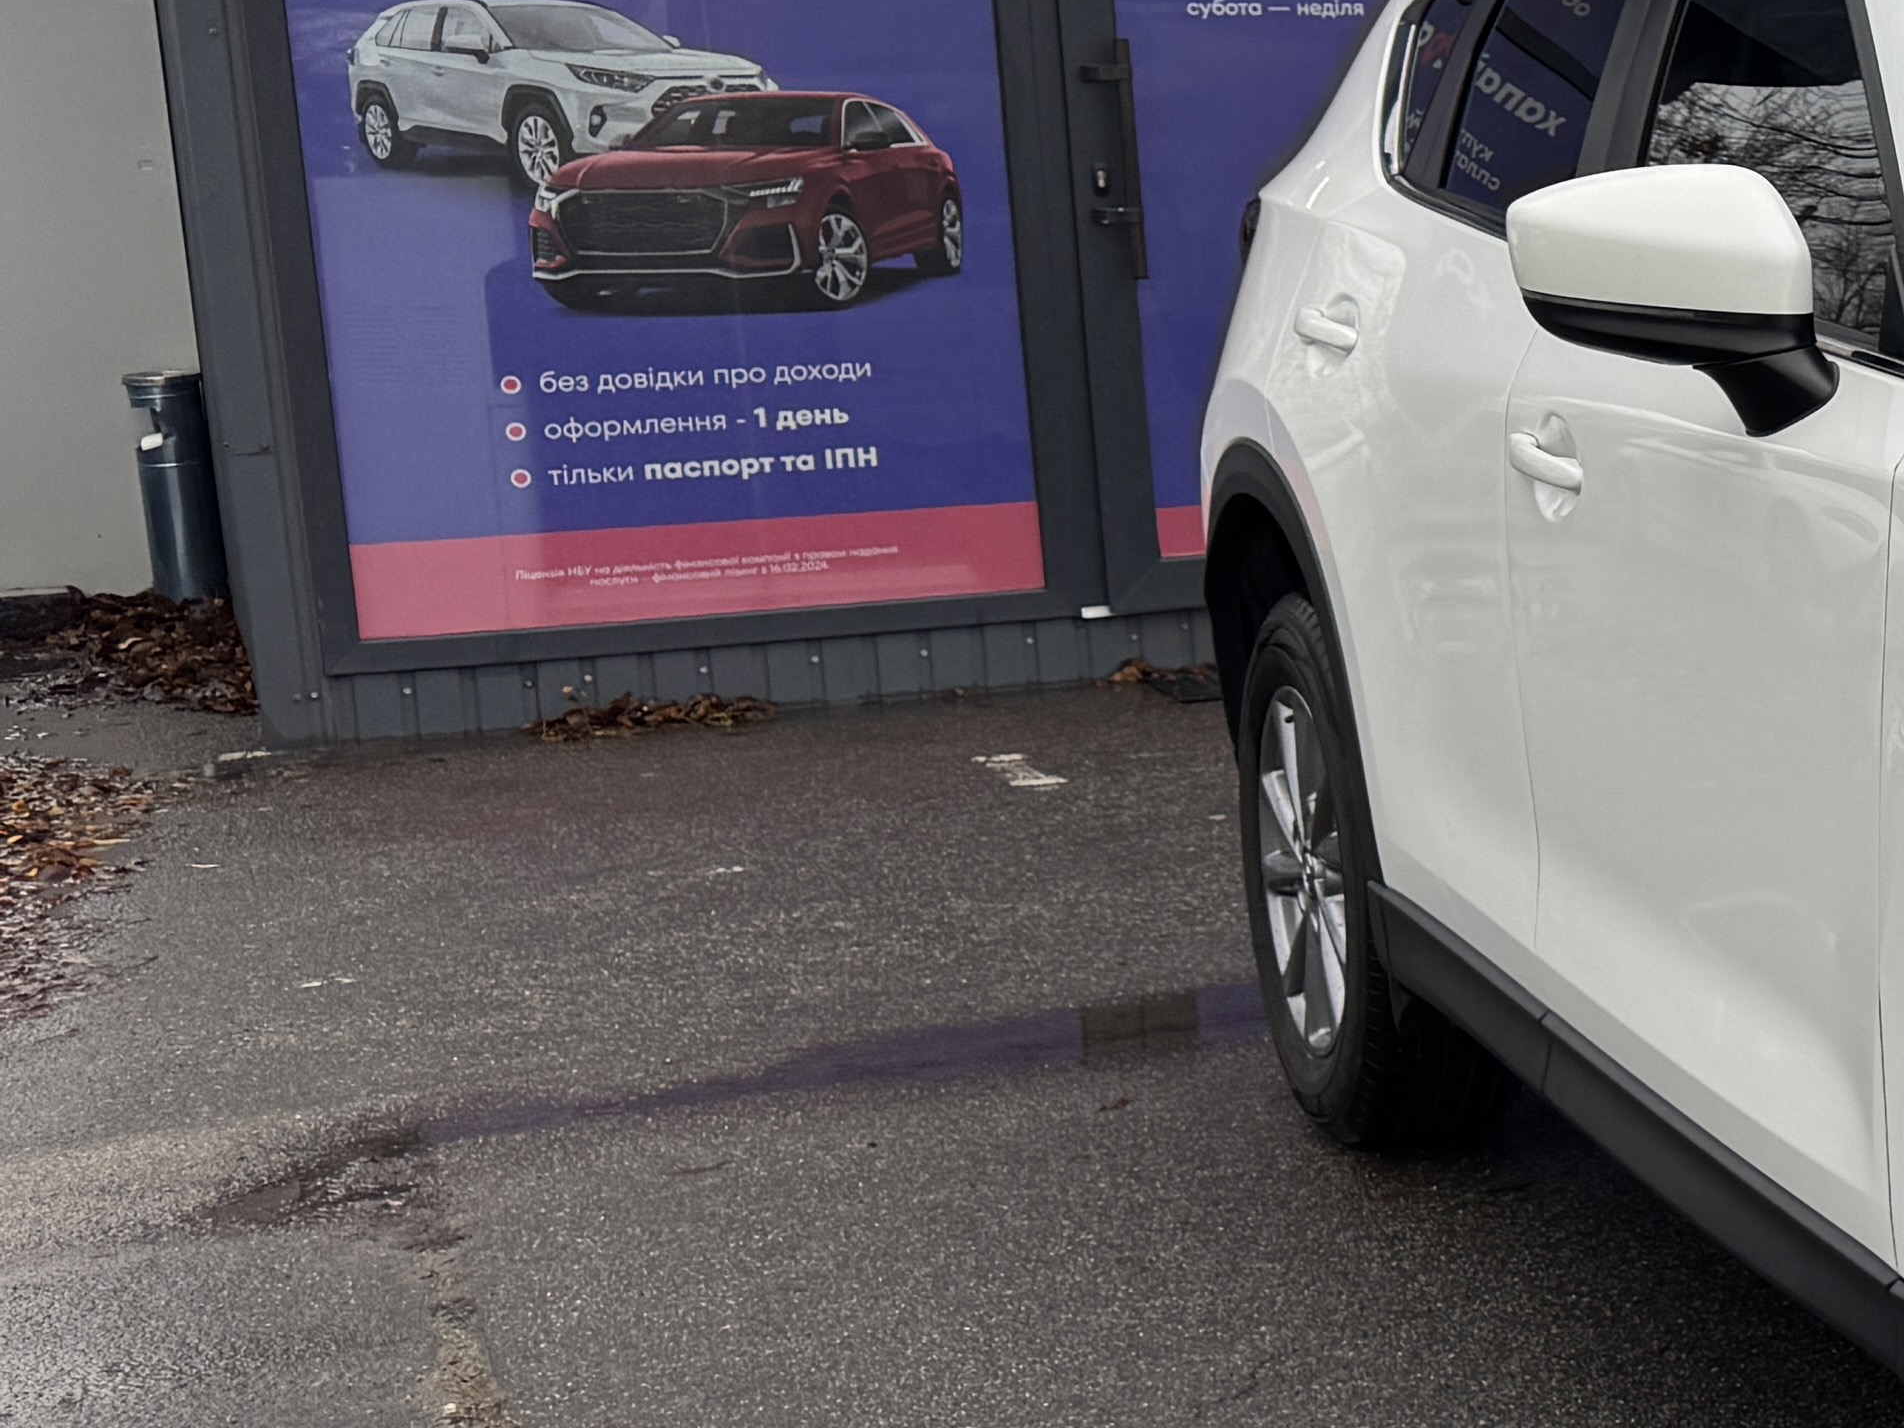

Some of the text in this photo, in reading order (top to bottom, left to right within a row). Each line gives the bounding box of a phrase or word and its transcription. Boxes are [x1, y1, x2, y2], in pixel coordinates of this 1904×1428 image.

[1296, 0, 1364, 19] неділя
[539, 361, 872, 395] без довідки про доходи
[544, 414, 727, 443] оформлення
[752, 406, 768, 429] 1
[775, 408, 850, 431] день
[547, 445, 878, 486] тільки паспорт та ІПН
